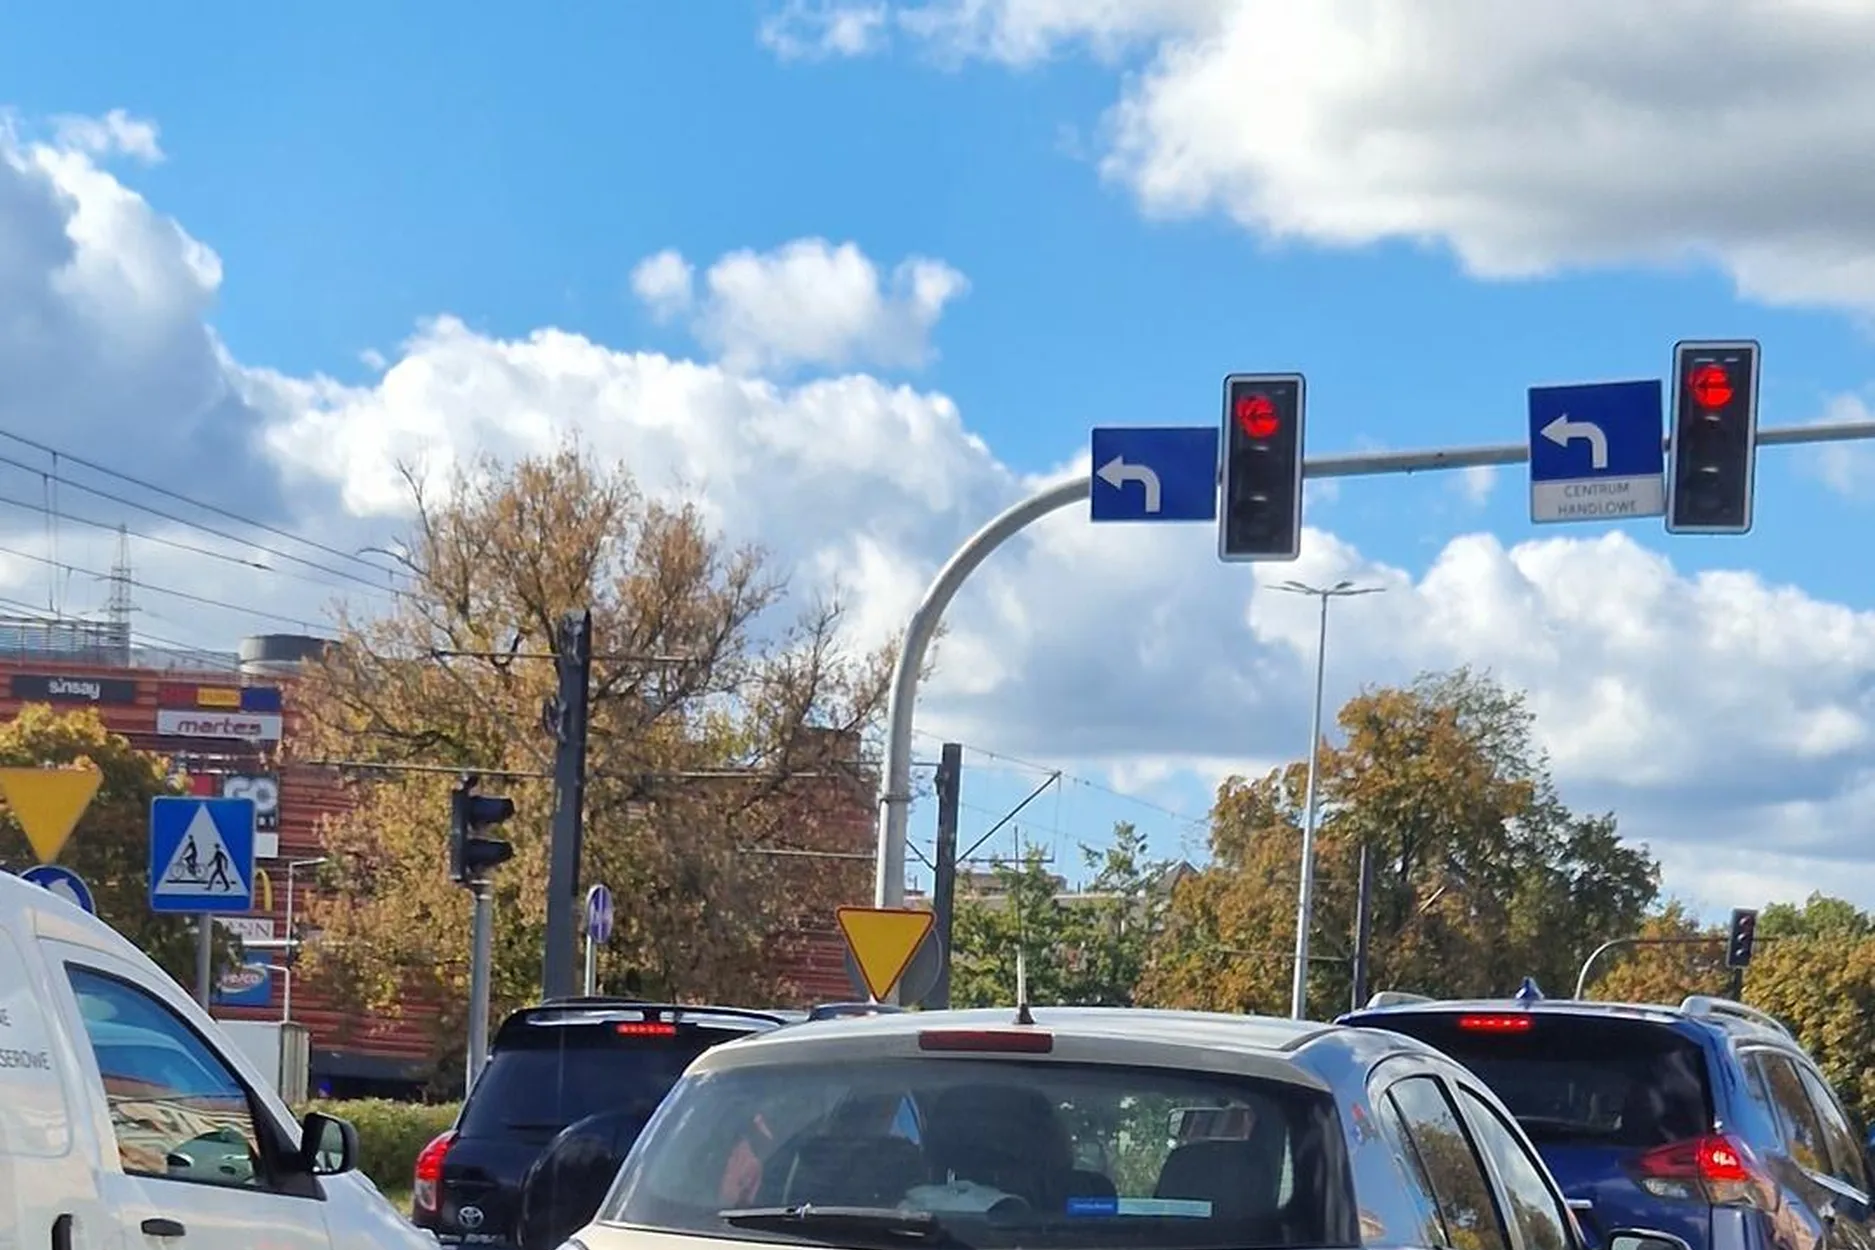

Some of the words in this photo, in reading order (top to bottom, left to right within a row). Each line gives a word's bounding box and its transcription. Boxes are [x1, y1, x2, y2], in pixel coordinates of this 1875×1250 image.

[1563, 482, 1630, 498] CENTRUM
[1558, 500, 1637, 515] HANDLOWE
[49, 678, 100, 699] sinsay
[177, 717, 262, 736] martes
